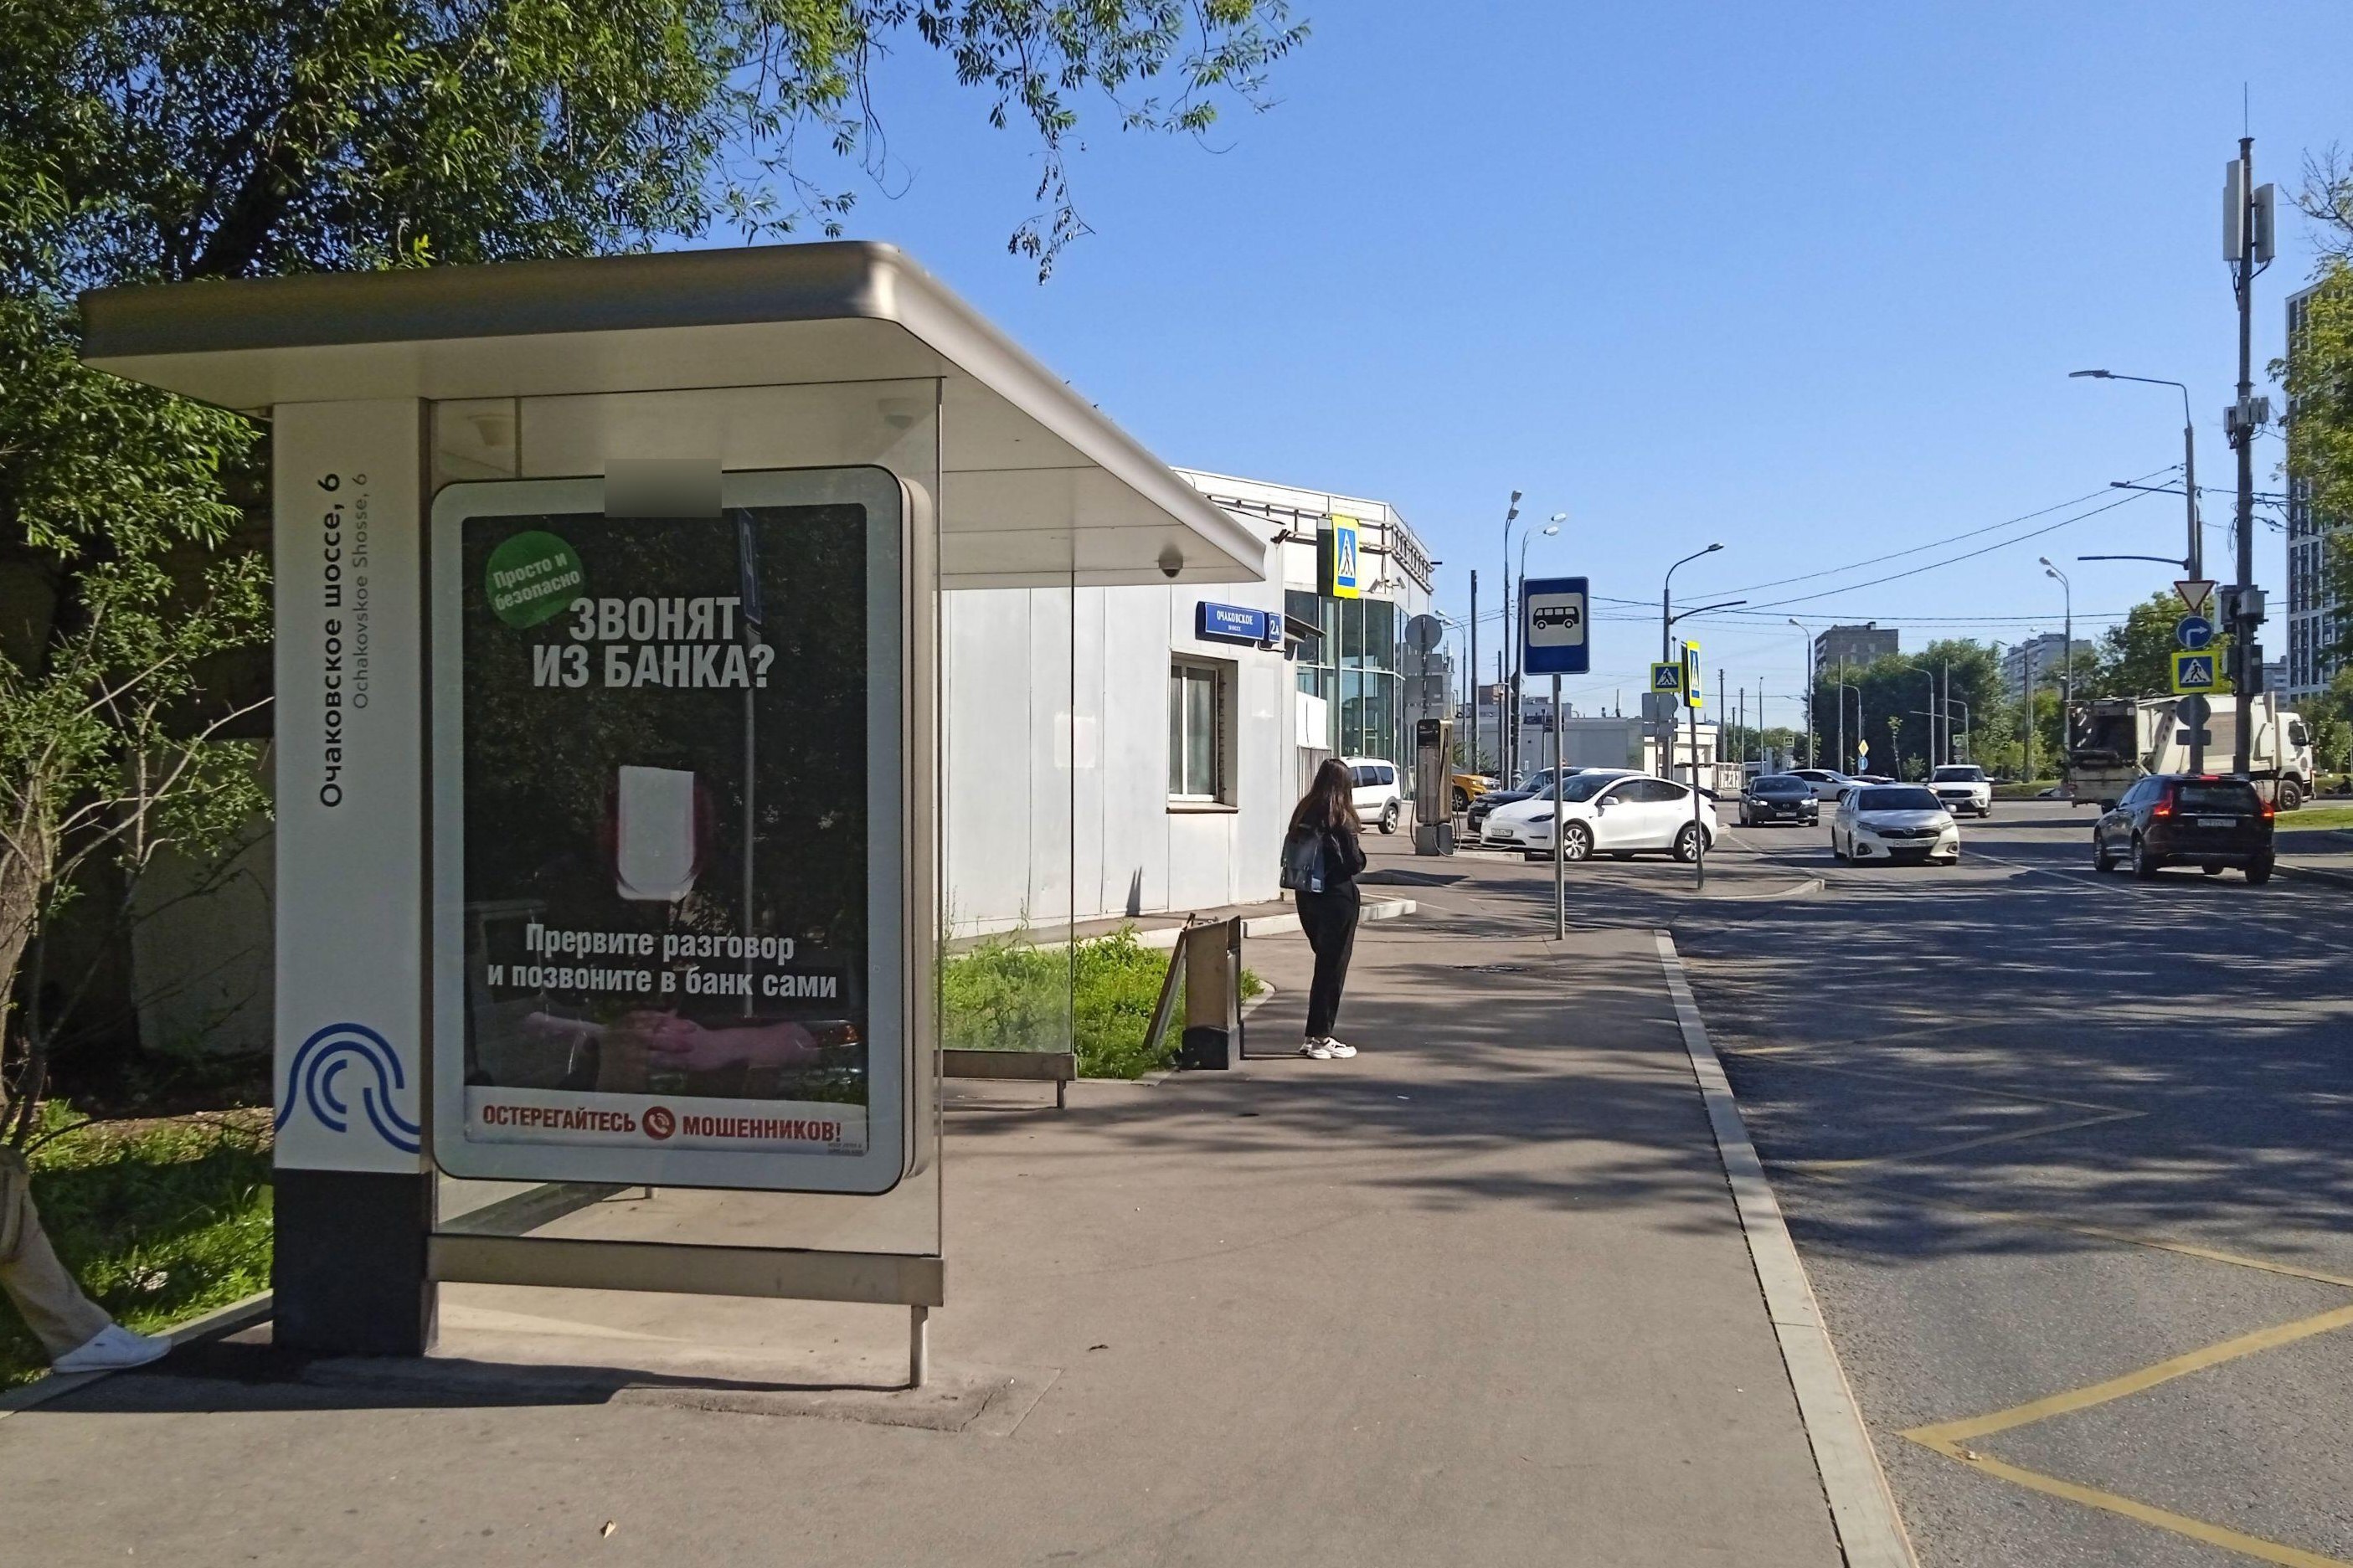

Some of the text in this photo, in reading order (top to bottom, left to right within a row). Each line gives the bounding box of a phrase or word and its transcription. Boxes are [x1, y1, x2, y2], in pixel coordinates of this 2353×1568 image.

[352, 473, 370, 709] Ochakovskoe Shosse, 6
[492, 553, 568, 589] Просто и
[494, 570, 581, 611] безопасно
[569, 596, 740, 641] ЗВОНЯТ
[1217, 610, 1253, 625] ОЧАКОВСКОЕ
[317, 473, 344, 807] Очаковское шоссе, 6
[533, 644, 775, 688] ИЗ БАНКА?
[526, 923, 794, 965] Прервите разговор
[487, 964, 837, 998] и позвоните в банк сами
[482, 1104, 842, 1144] ОСТЕРЕГАЙТЕСЬ МОШЕННИКОВ!
